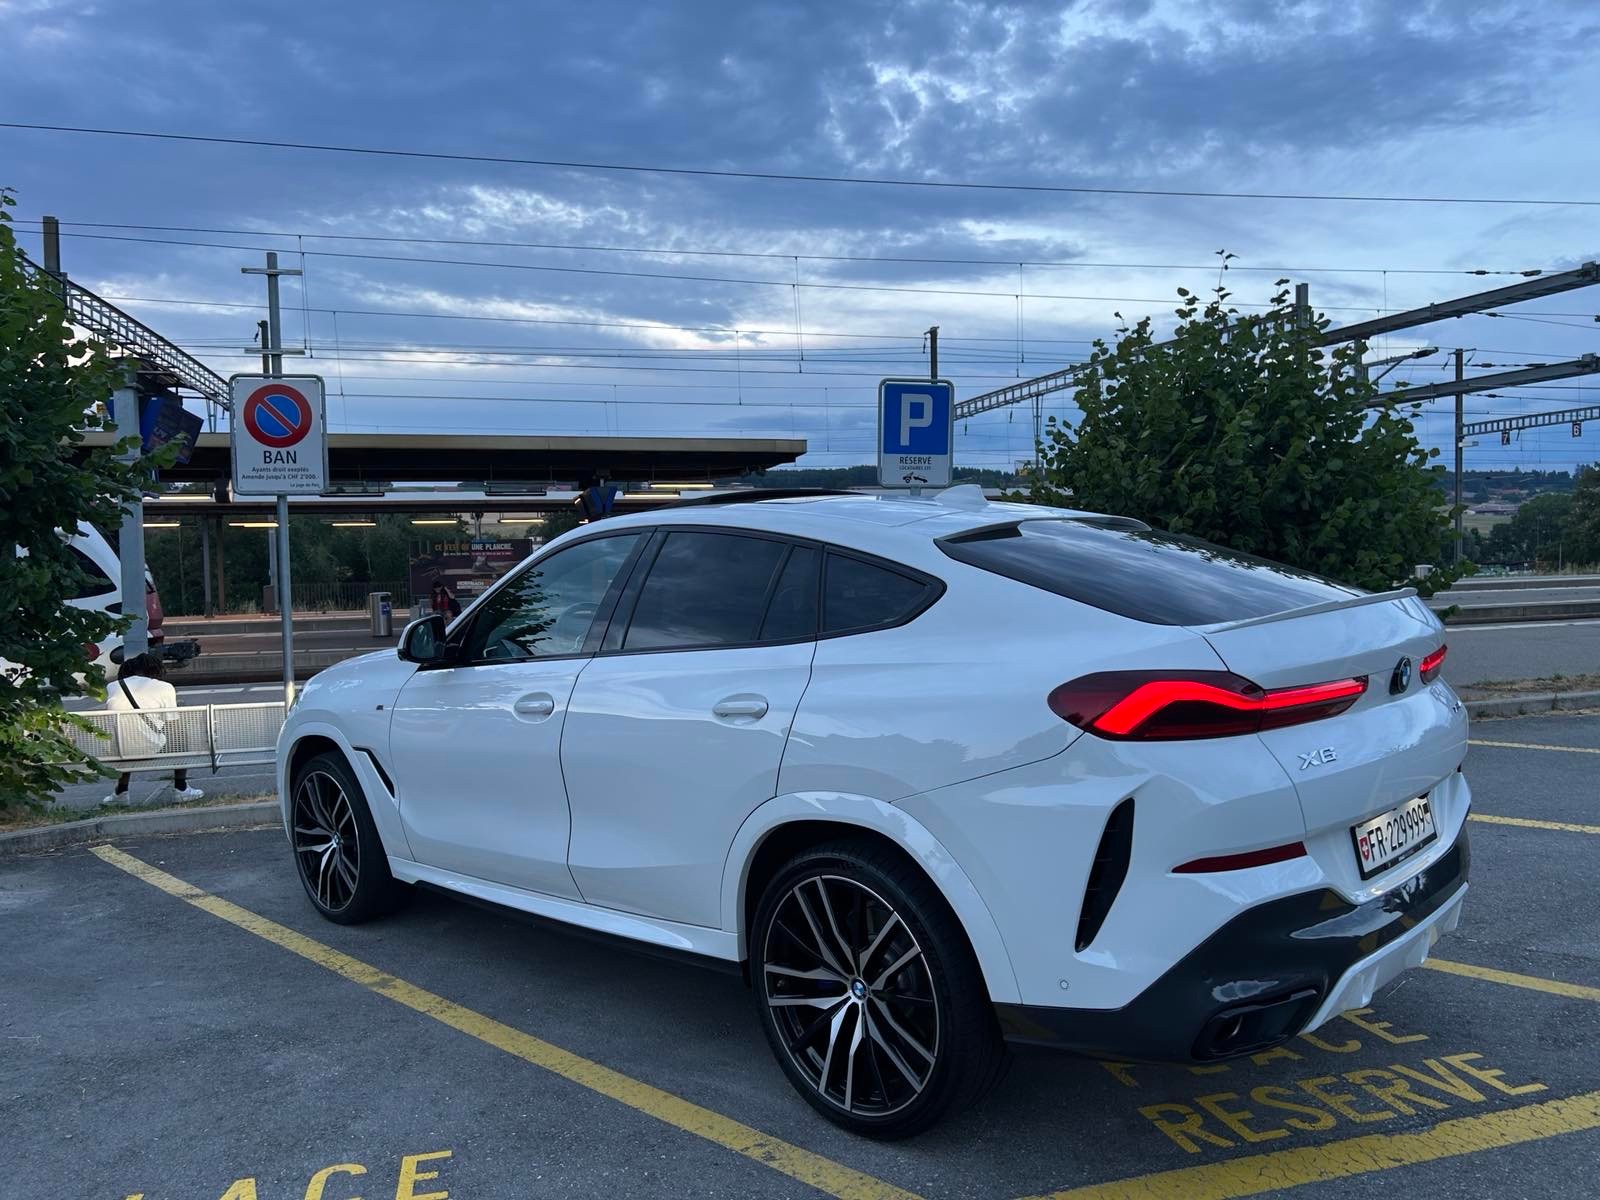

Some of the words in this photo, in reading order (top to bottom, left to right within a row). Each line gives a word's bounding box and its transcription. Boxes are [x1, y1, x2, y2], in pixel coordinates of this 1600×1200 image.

[900, 393, 933, 446] P
[263, 451, 297, 464] BAN
[1296, 748, 1337, 771] X6
[1138, 1052, 1548, 1154] RESERVE
